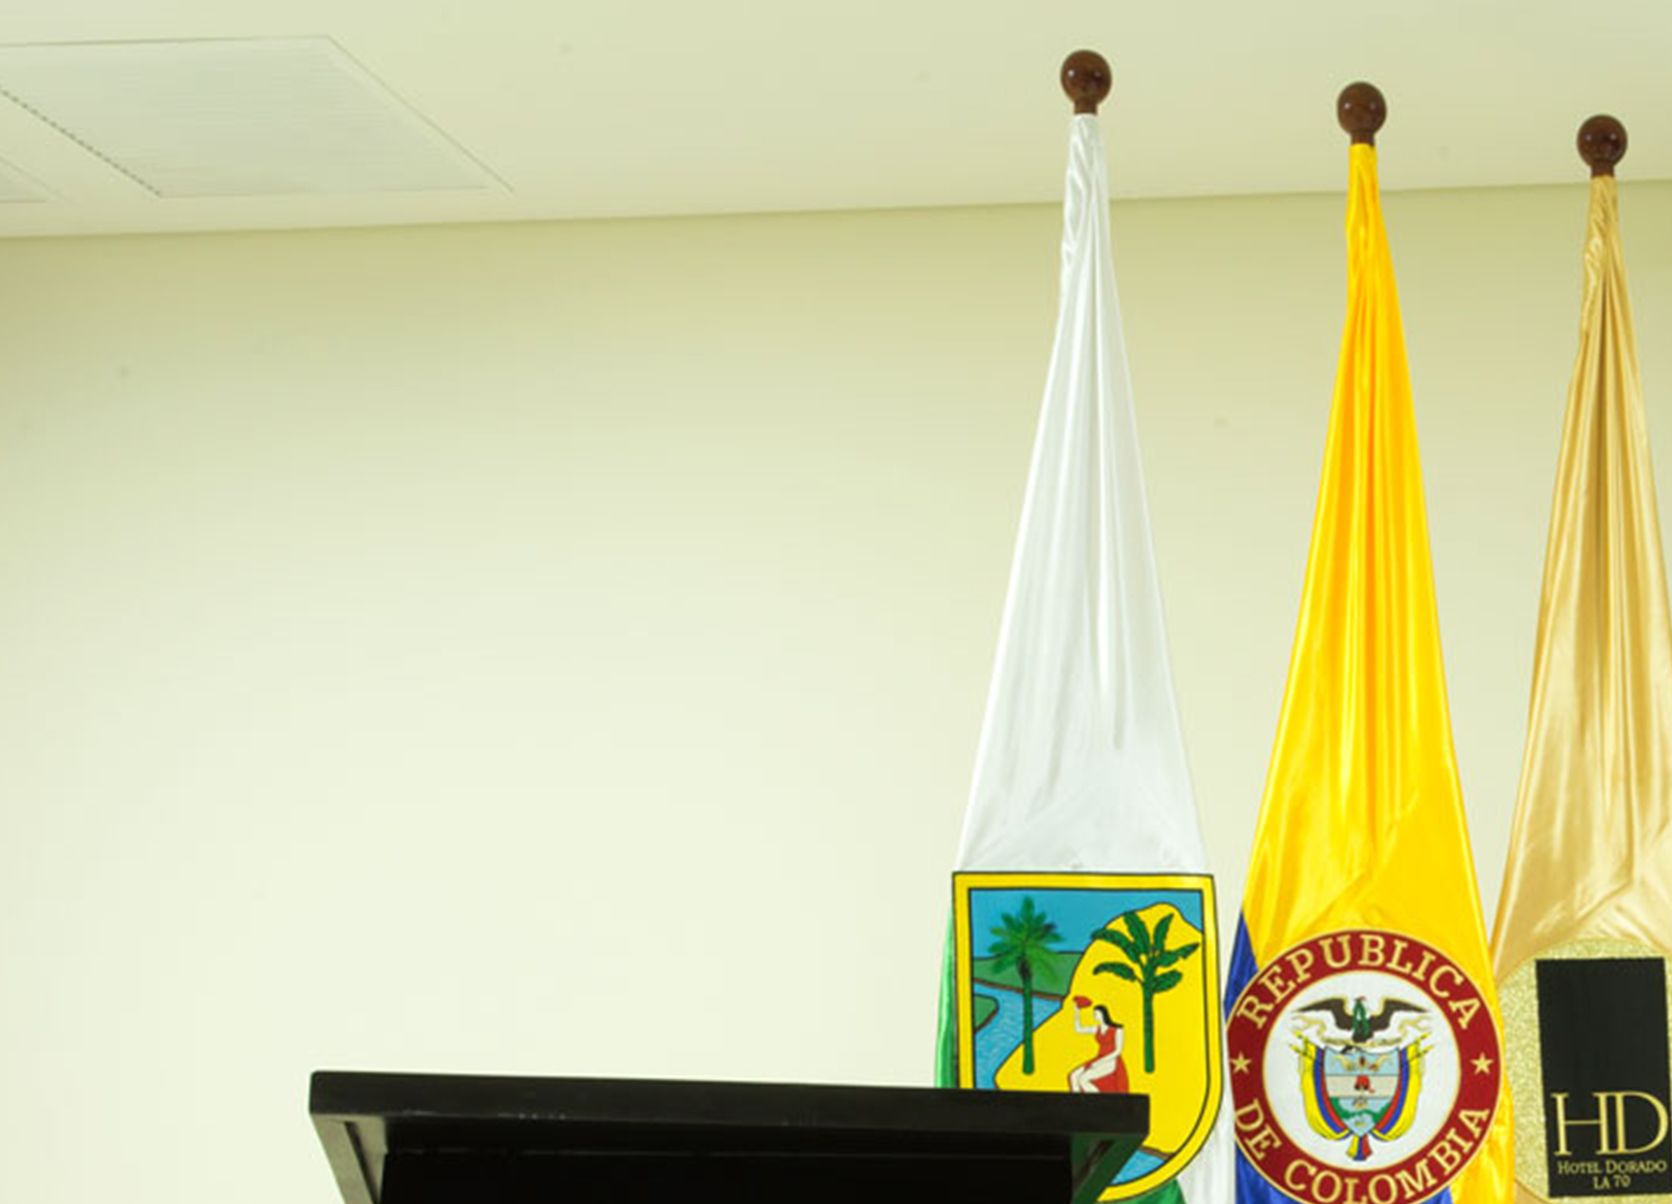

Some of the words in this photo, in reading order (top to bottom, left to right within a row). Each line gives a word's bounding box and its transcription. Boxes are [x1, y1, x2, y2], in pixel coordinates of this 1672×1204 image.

[1236, 934, 1481, 1029] REPUBLICA
[1235, 1098, 1281, 1160] DE
[1550, 1089, 1669, 1156] HD
[1557, 1160, 1602, 1175] HOTEL
[1605, 1158, 1668, 1174] DORADO
[1593, 1176, 1610, 1190] LA
[1613, 1174, 1631, 1188] 70
